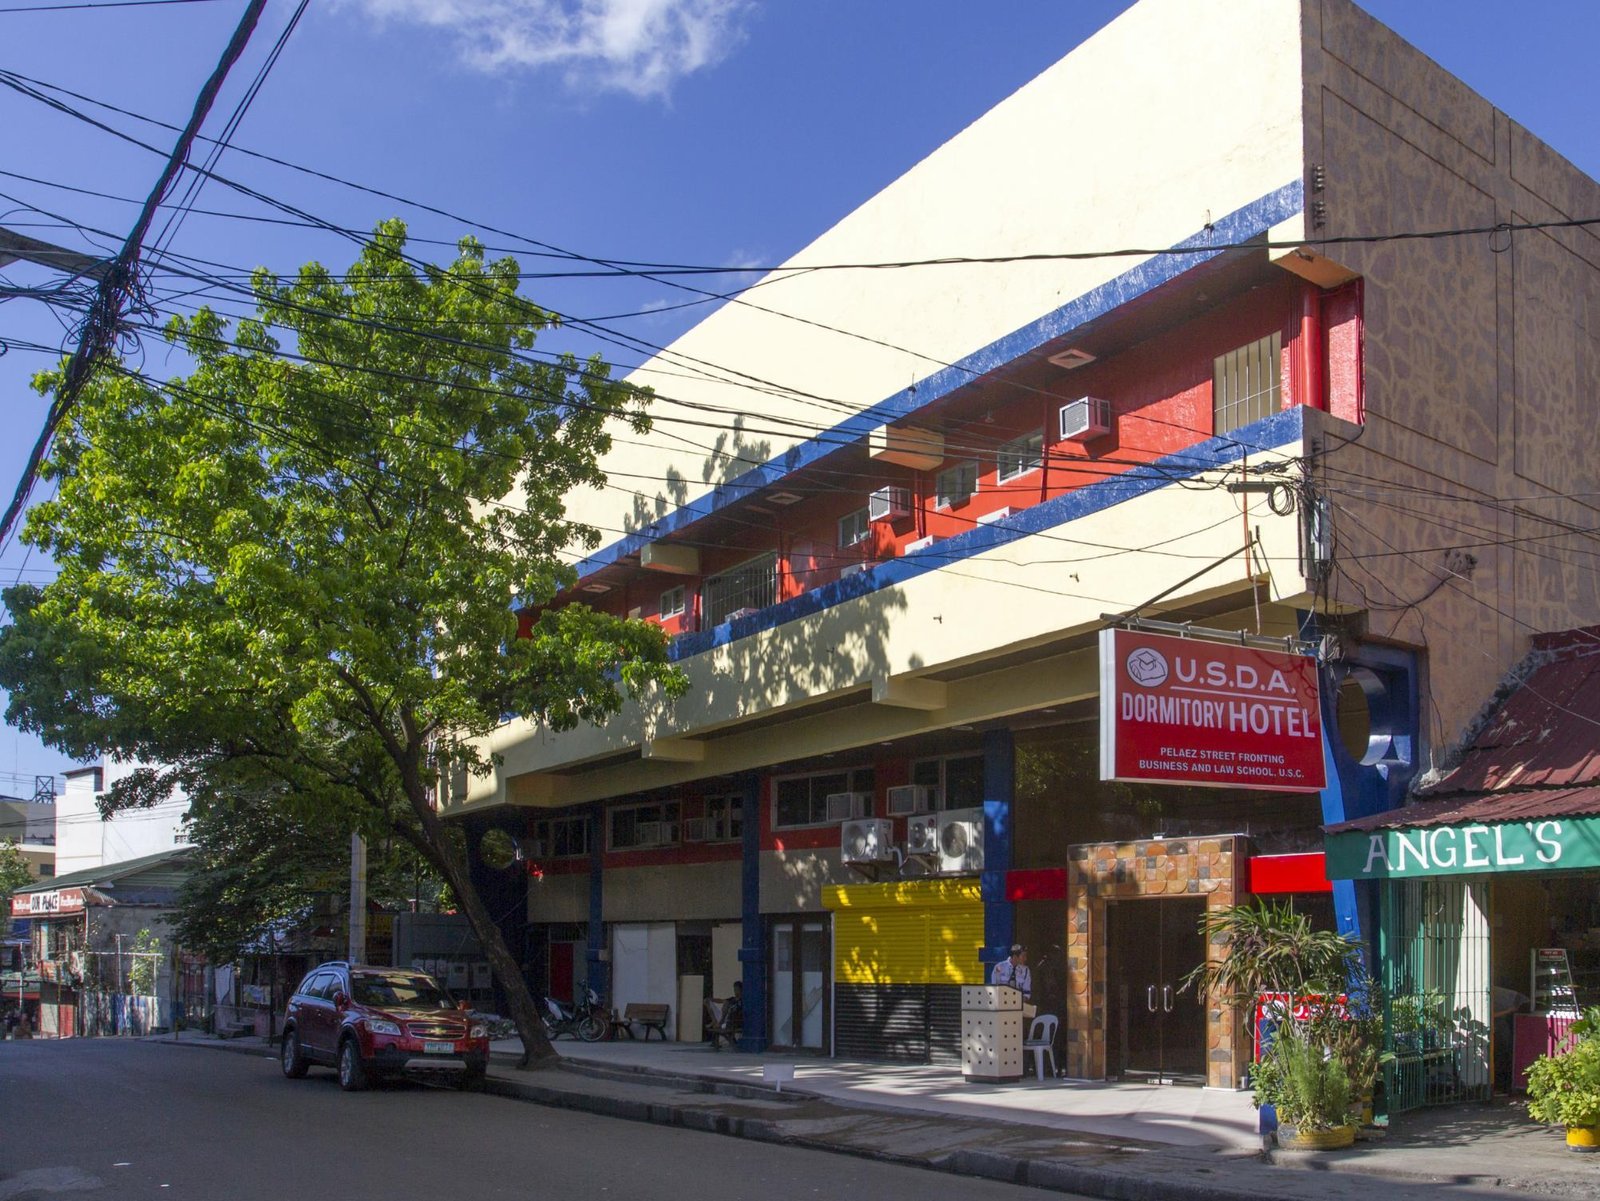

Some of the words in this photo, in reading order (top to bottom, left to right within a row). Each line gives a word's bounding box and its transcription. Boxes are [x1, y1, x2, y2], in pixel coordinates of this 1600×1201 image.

[1175, 657, 1297, 694] U.S.D.A.
[1122, 692, 1225, 729] DORMITORY
[1229, 701, 1316, 738] HOTEL
[1139, 760, 1189, 772] BUSINESS
[1191, 763, 1212, 773] AND
[1214, 764, 1235, 774] LAW
[1279, 768, 1305, 778] U.S.C.
[1160, 747, 1197, 759] PELAEZ
[1200, 749, 1236, 761] STREET
[1238, 752, 1285, 764] FRONTING
[1363, 820, 1562, 873] ANGEL'S
[32, 896, 40, 910] OUR
[42, 894, 58, 910] PLACE
